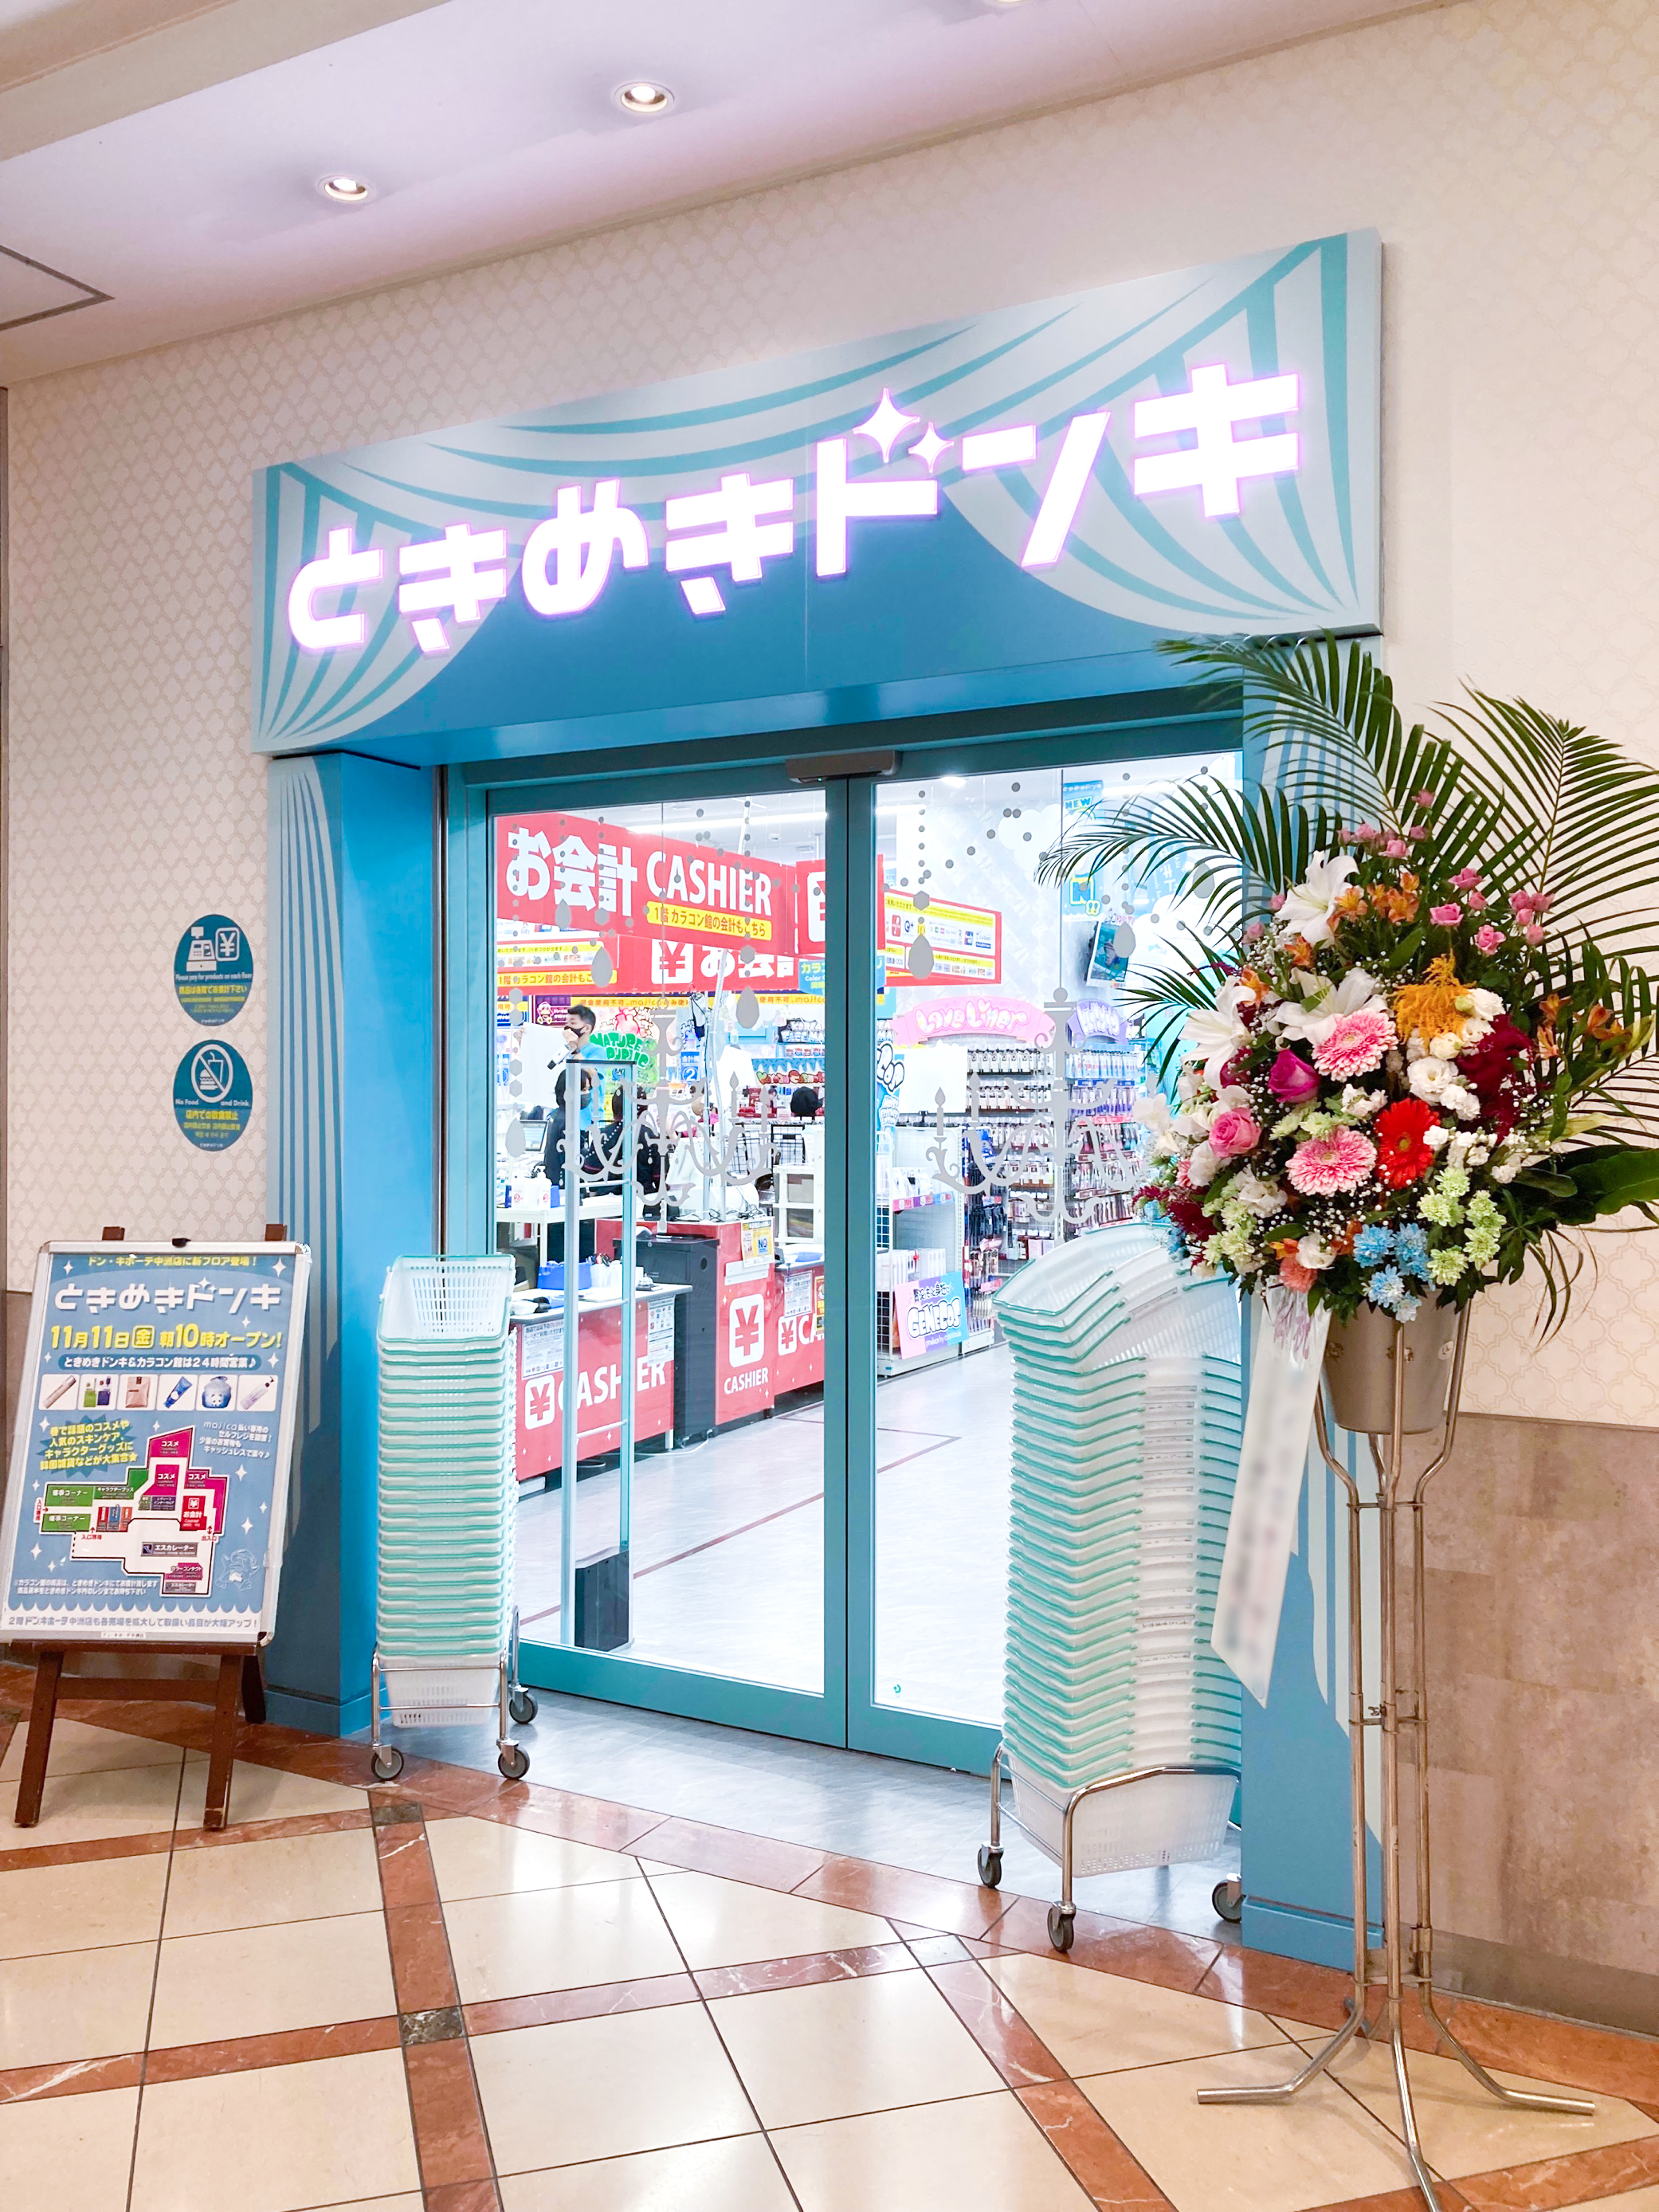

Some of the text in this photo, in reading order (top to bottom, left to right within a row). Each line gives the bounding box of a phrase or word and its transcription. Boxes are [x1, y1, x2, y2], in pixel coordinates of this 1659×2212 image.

[287, 363, 1300, 655] ときめきドンキ
[505, 826, 772, 916] お会計 CASHIER
[53, 1281, 282, 1315] ときめきドンキ
[724, 1367, 769, 1395] CASHIER
[45, 1441, 134, 1459] キャラクターグッズに
